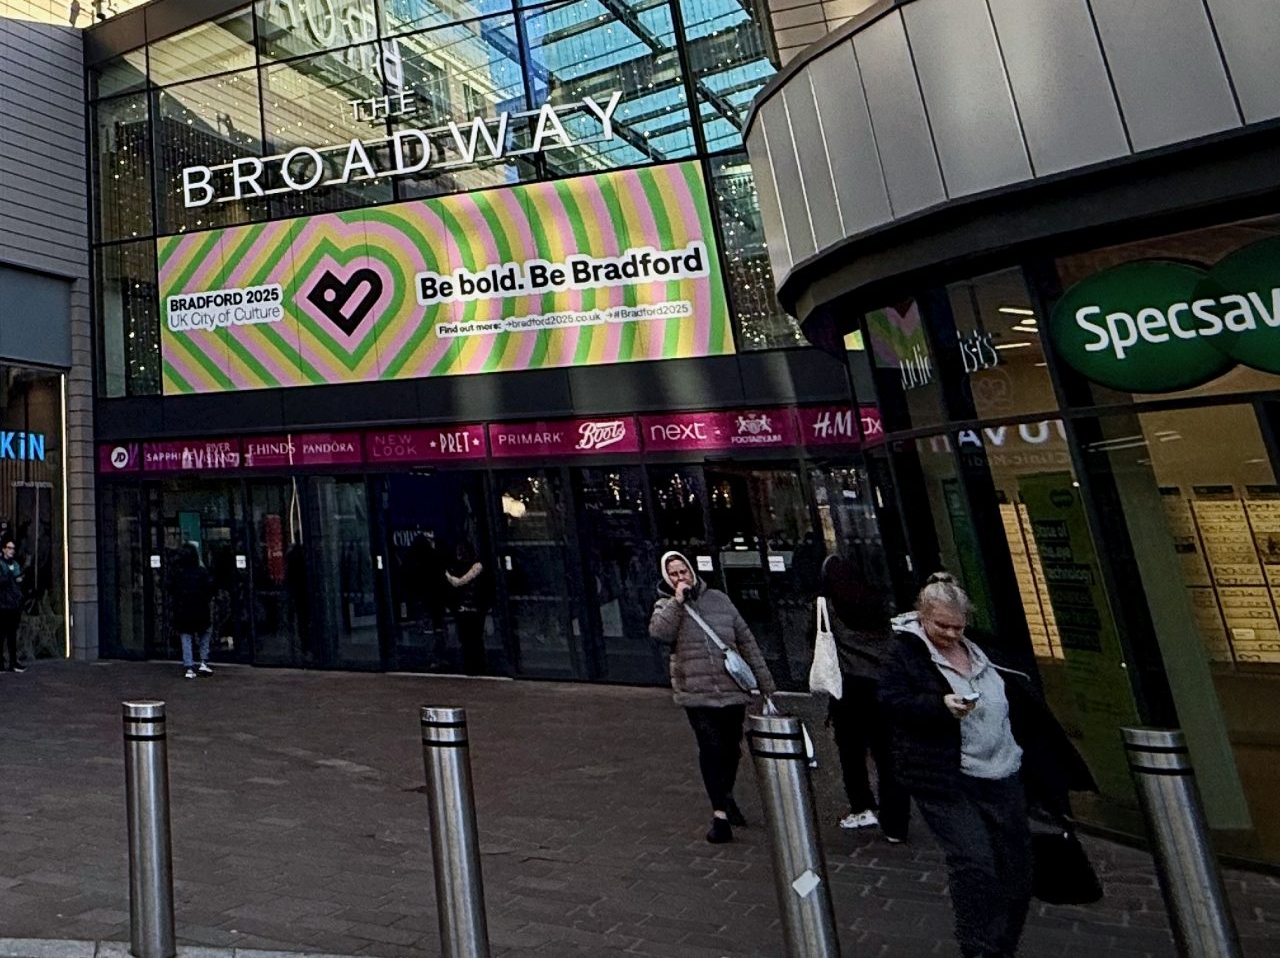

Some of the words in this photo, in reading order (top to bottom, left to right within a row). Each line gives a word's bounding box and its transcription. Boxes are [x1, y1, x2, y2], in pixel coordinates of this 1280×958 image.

[348, 90, 417, 122] THE
[182, 90, 624, 210] BROADWAY
[421, 276, 454, 300] Be
[460, 268, 525, 297] bold.
[530, 264, 567, 289] Be
[572, 247, 703, 286] Bradford
[170, 292, 243, 312] BRADFORD
[246, 288, 279, 304] 2025
[170, 313, 188, 328] UK
[191, 311, 215, 328] City
[218, 308, 231, 323] of
[234, 306, 281, 322] Culture
[439, 325, 458, 334] Find
[459, 324, 474, 333] out
[476, 323, 501, 332] more:
[575, 420, 626, 450] Boots
[650, 421, 707, 441] next
[813, 409, 852, 439] H&M
[302, 439, 355, 454] PANDORA
[375, 435, 412, 446] NEW
[439, 431, 470, 454] PRET
[498, 432, 562, 445] PRIMARK
[373, 445, 417, 457] LOOK
